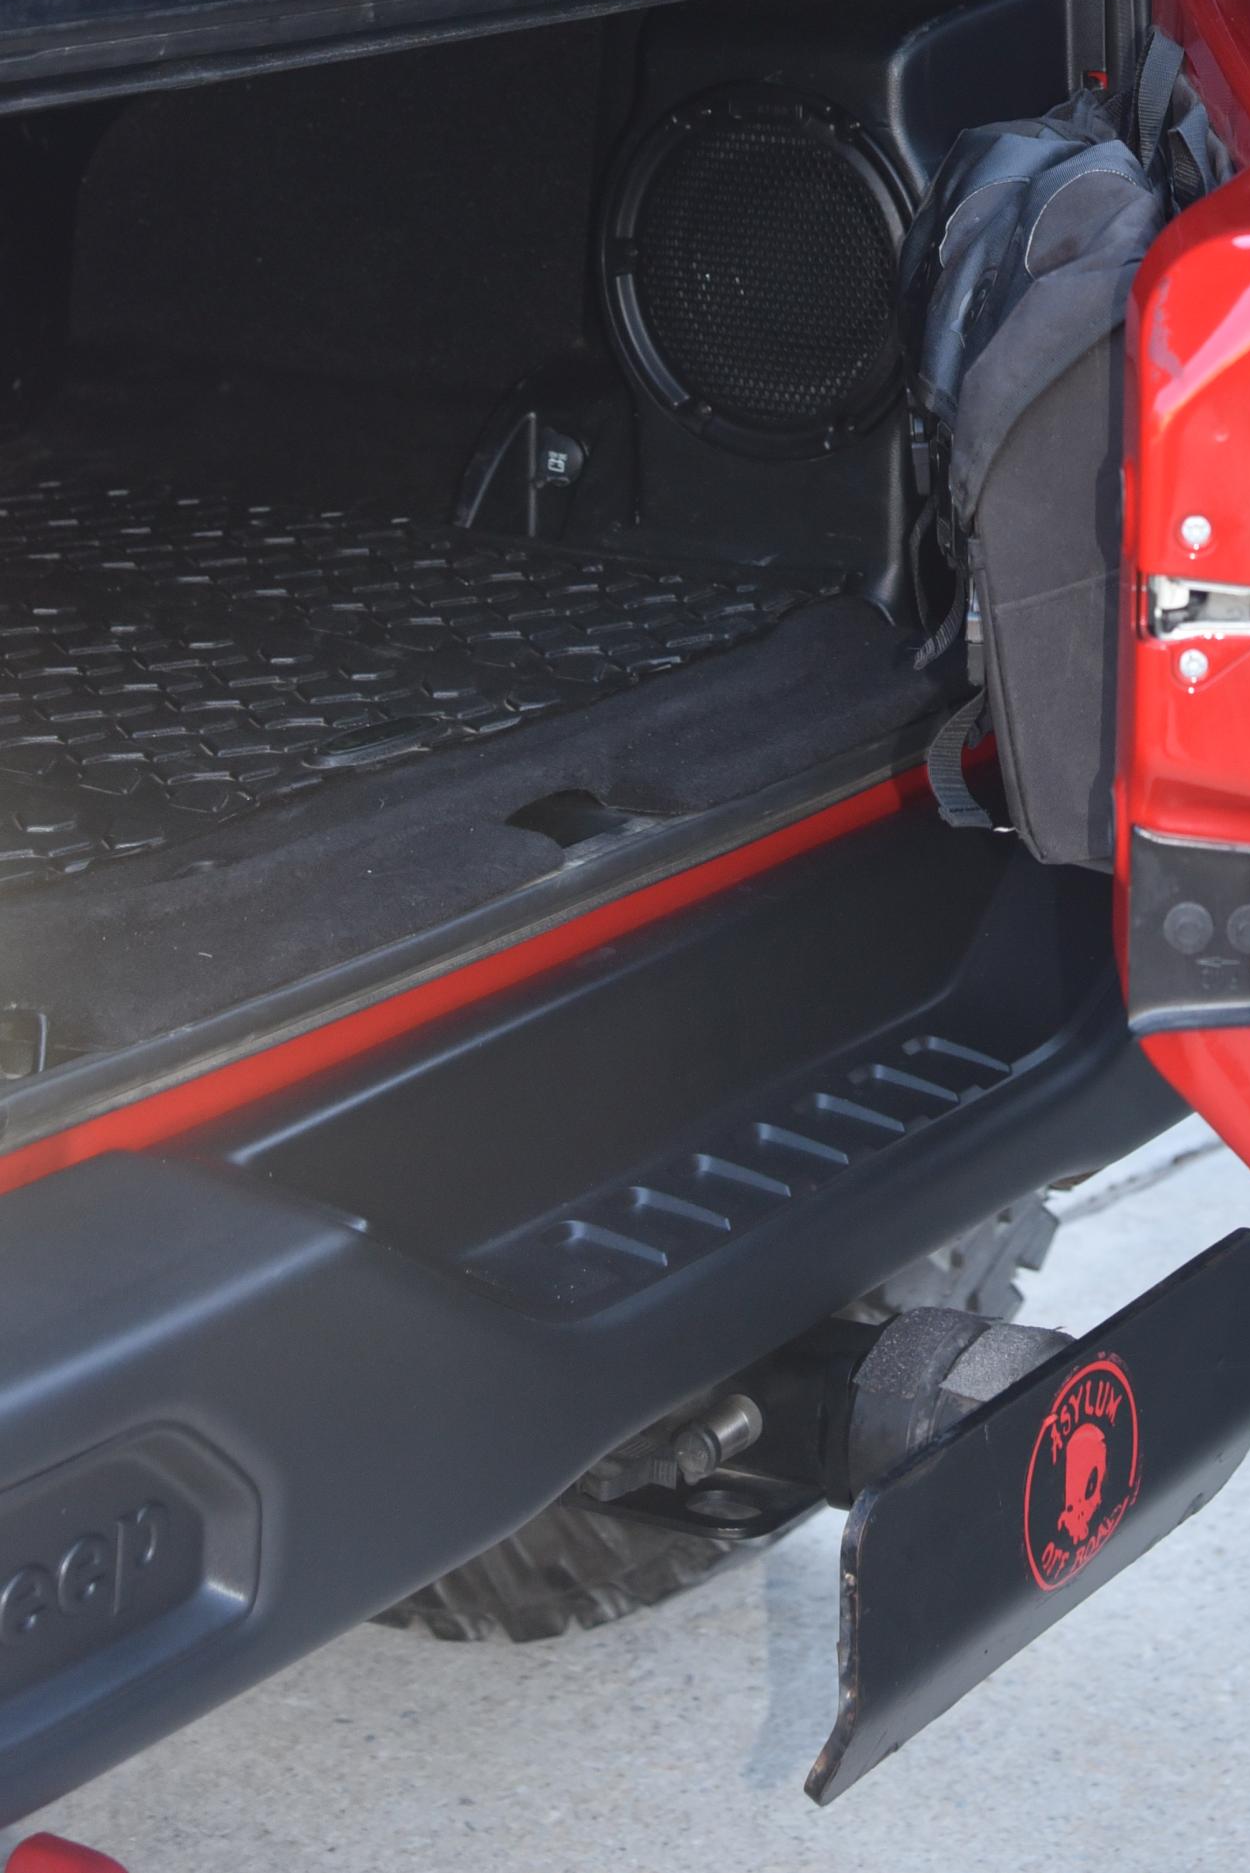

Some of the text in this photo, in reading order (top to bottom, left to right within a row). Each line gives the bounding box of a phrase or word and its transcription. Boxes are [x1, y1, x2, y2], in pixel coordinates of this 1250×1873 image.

[1049, 1379, 1123, 1465] ASYLUM
[0, 1502, 168, 1644] eep
[1041, 1541, 1070, 1580] OFF
